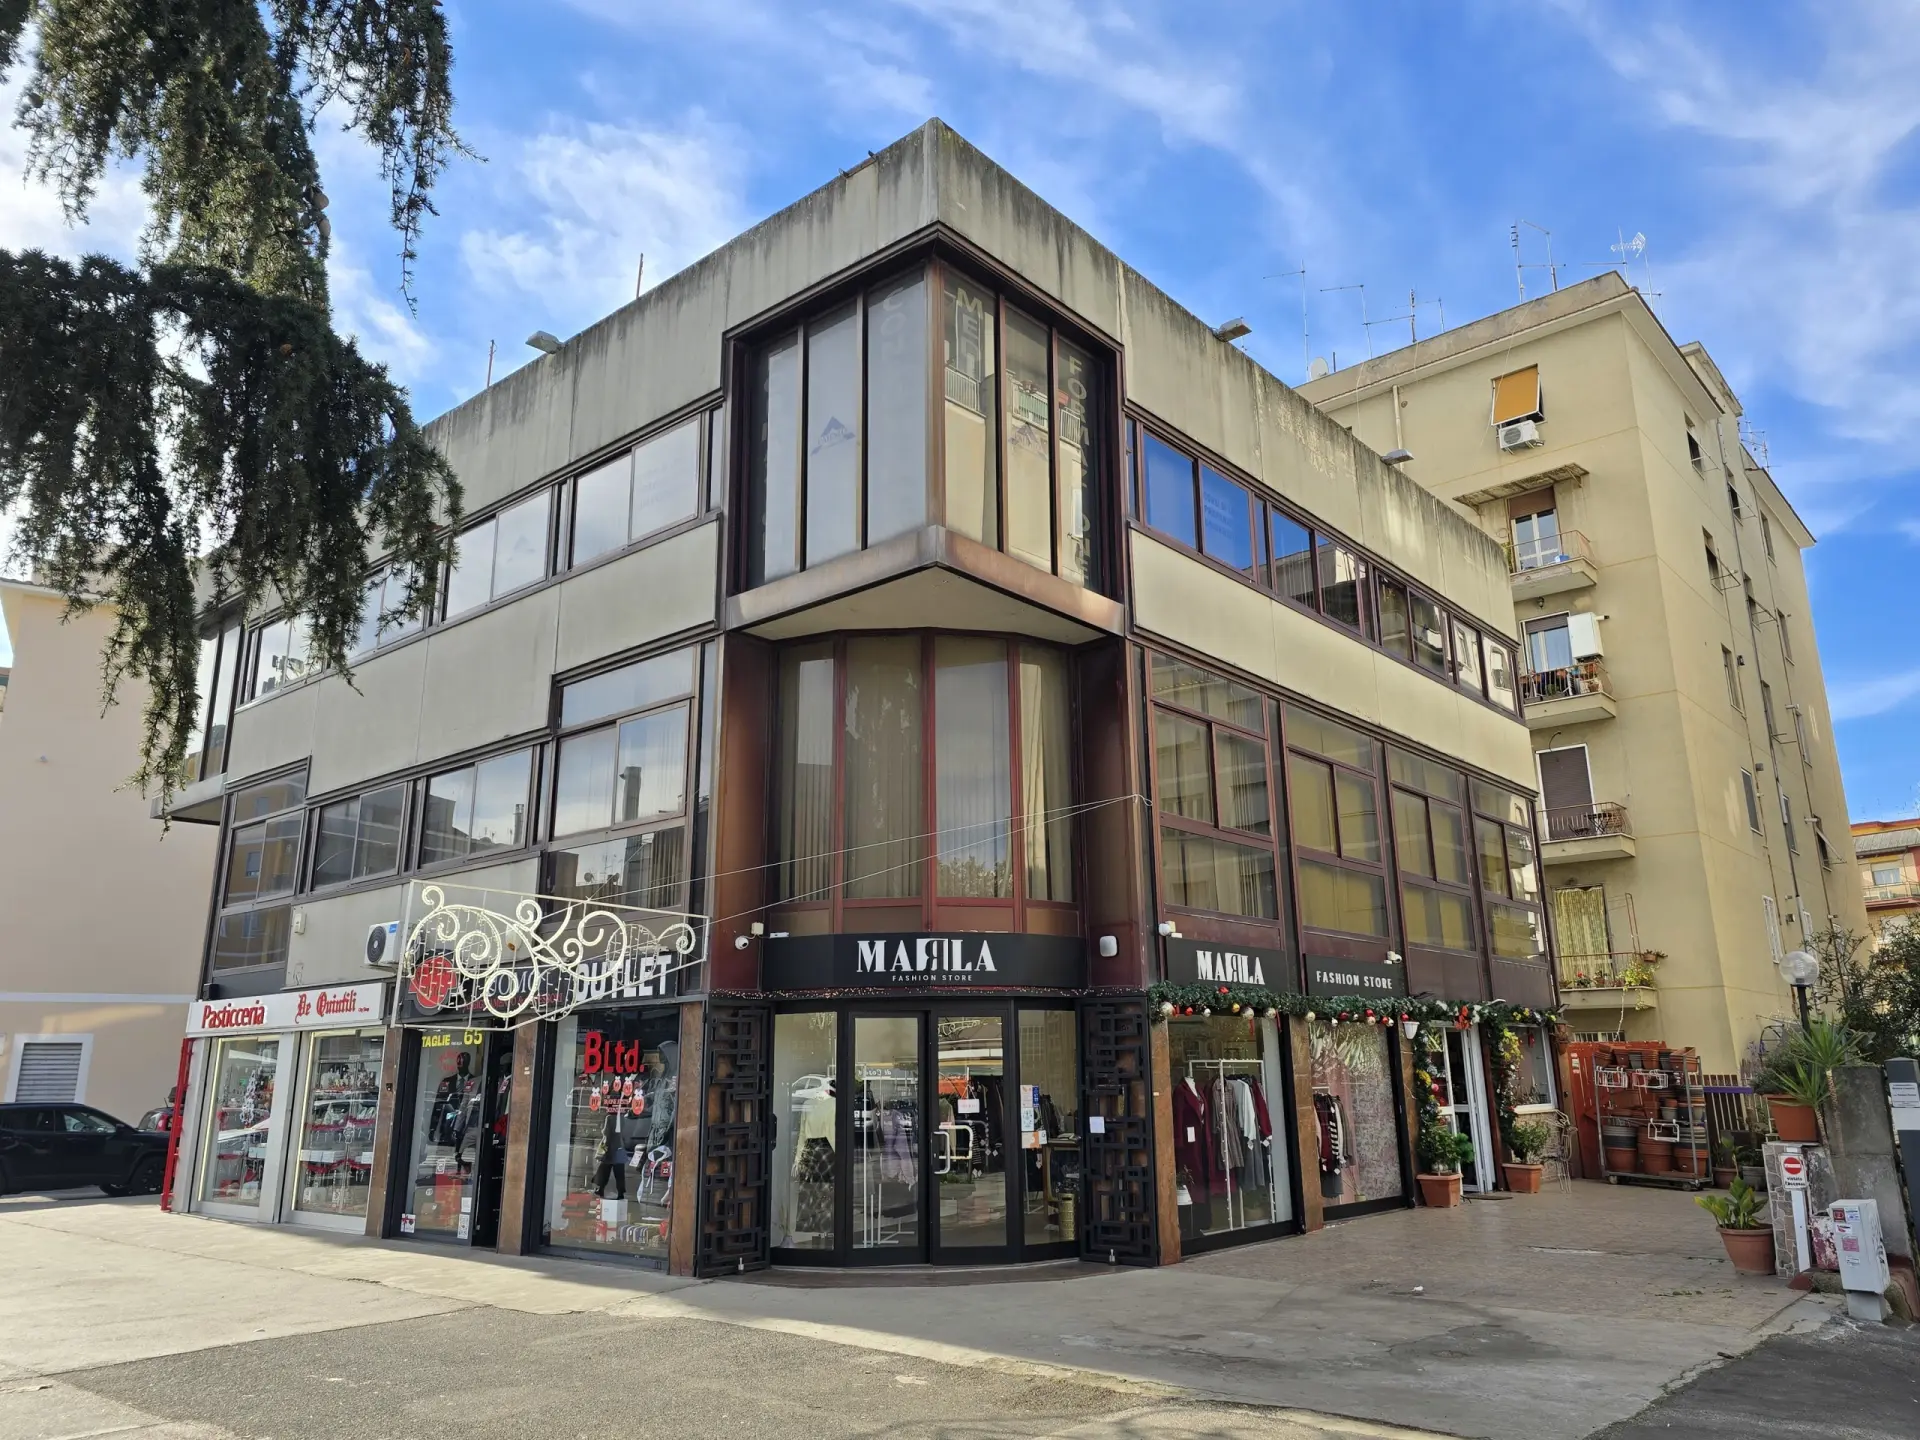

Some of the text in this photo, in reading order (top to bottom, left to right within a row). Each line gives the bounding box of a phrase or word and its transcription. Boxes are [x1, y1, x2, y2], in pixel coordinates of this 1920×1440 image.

[577, 954, 672, 1000] OUTLET
[892, 974, 936, 982] FASHION
[1316, 970, 1393, 989] FASHION STORE
[202, 1000, 265, 1028] Pasticceria
[422, 1034, 451, 1047] TAGLIE
[464, 1029, 483, 1045] 65
